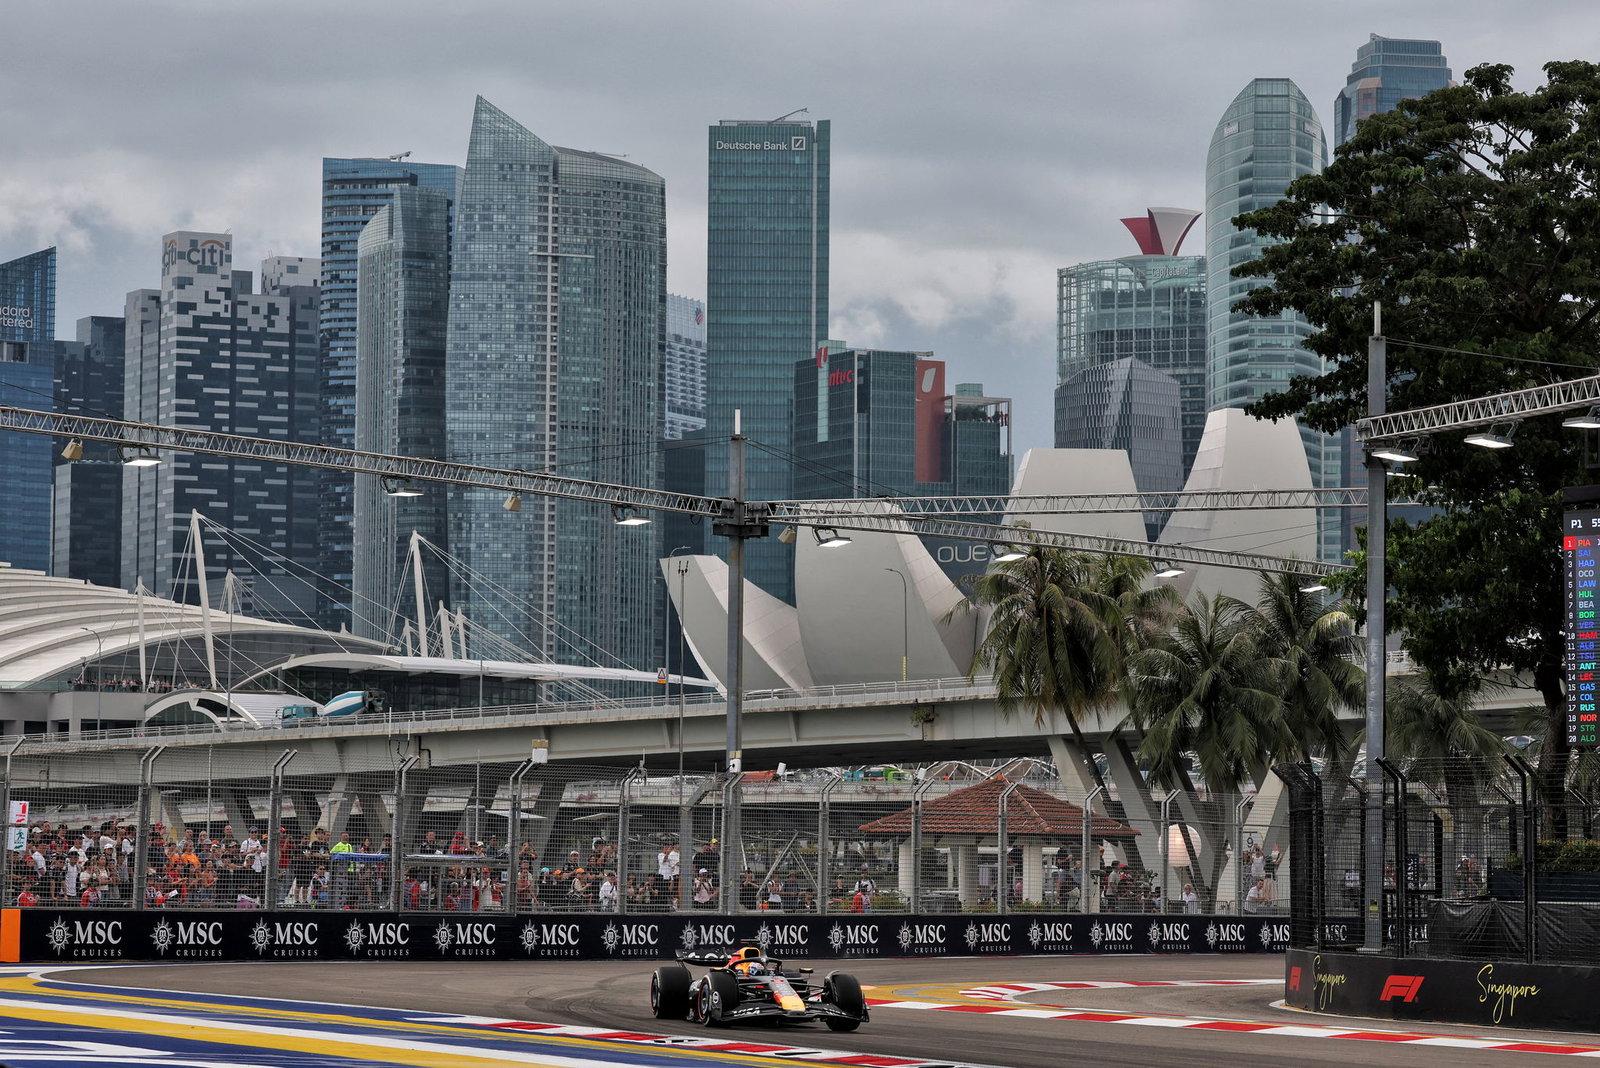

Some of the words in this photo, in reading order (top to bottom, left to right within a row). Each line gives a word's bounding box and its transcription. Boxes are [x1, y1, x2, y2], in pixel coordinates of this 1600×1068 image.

[716, 140, 761, 150] Deutsche
[763, 141, 788, 150] Bank
[187, 243, 224, 266] citi
[0, 305, 30, 317] dard
[1571, 519, 1583, 529] P1
[937, 544, 988, 563] OUE
[1578, 580, 1597, 588] LAW
[1580, 662, 1596, 670] ANT
[1580, 683, 1595, 691] GAS
[1580, 714, 1597, 722] NOR
[1246, 837, 1253, 848] 9
[74, 921, 121, 944] MSC
[176, 922, 222, 945] MSC
[274, 922, 317, 945] MSC
[367, 923, 409, 945] MSC
[455, 923, 496, 945] MSC
[541, 924, 579, 945] MSC
[622, 924, 658, 945] MSC
[700, 925, 735, 945] MSC
[775, 925, 808, 945] MSC
[846, 925, 878, 944] MSC
[914, 924, 946, 944] MSC
[980, 923, 1011, 942] MSC
[1044, 923, 1072, 942] MSC
[1104, 922, 1133, 941] MSC
[1162, 923, 1190, 941] MSC
[1219, 923, 1246, 942] MSC
[1273, 924, 1290, 942] MS
[1313, 955, 1347, 1010] Singapore
[1380, 975, 1425, 1002] F1
[1477, 964, 1541, 1024] Singapore
